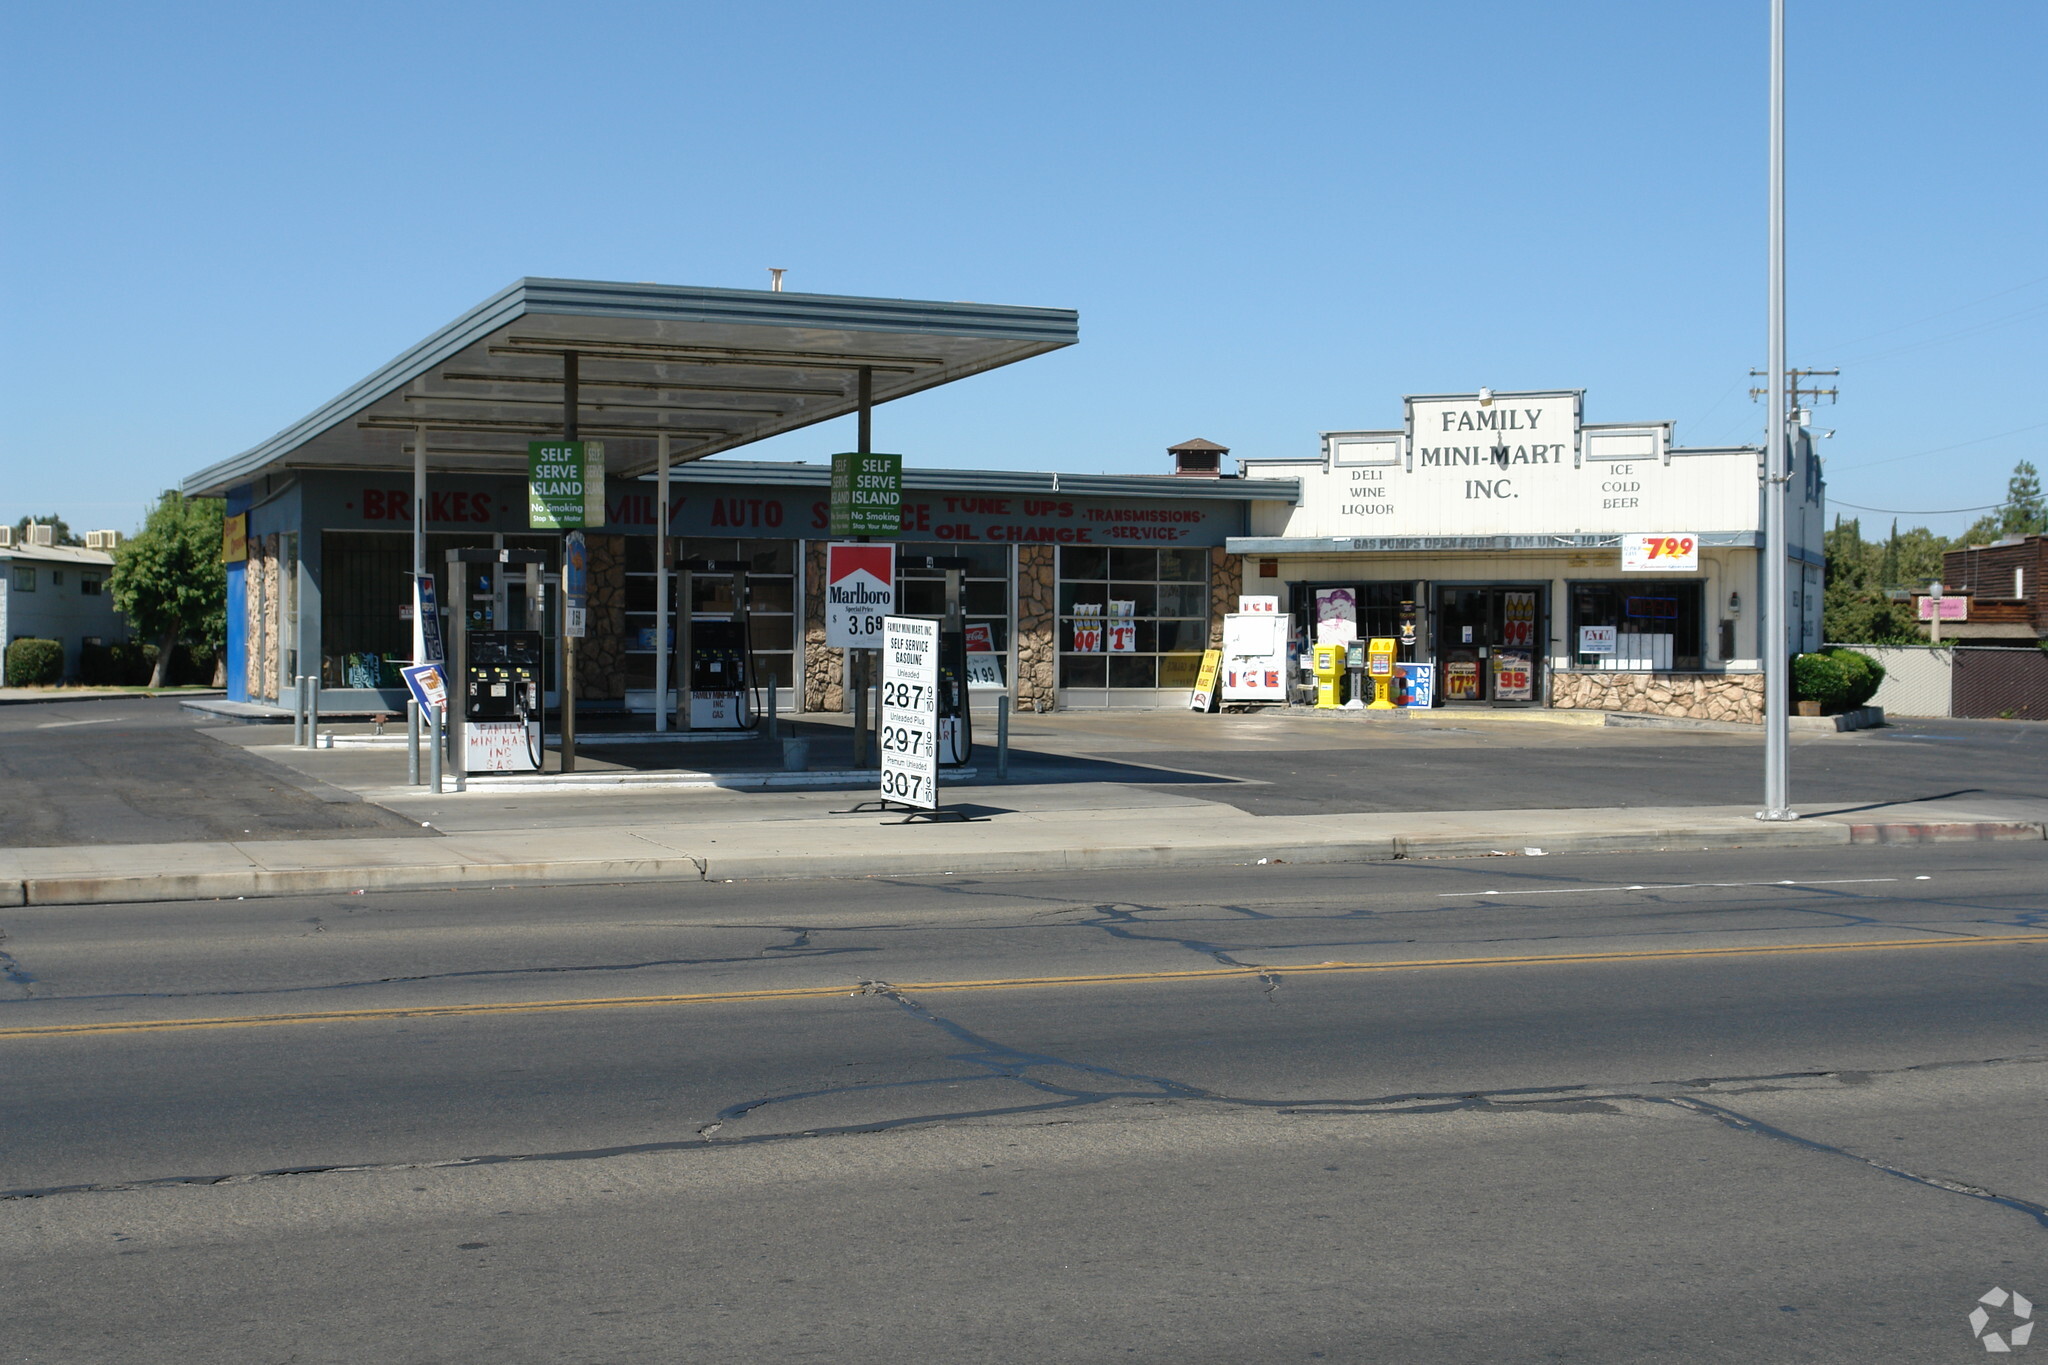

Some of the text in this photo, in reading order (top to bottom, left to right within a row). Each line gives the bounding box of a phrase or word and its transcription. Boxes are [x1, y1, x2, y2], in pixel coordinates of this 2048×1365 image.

[1442, 408, 1543, 431] FAMILY
[541, 448, 572, 462] SELF
[1421, 444, 1565, 467] MINI-MART
[536, 465, 577, 478] SERVE
[862, 459, 892, 472] SELF
[1610, 464, 1634, 475] ICE
[1351, 470, 1383, 480] DELI
[532, 482, 583, 495] ISLAND
[857, 475, 896, 489] SERVE
[1602, 482, 1640, 493] COLD
[1350, 487, 1386, 498] WINE
[1465, 479, 1519, 500] INC.
[852, 491, 900, 505] ISLAND
[1602, 498, 1639, 509] BEER
[531, 503, 544, 512] No
[547, 503, 583, 513] Smoking
[605, 495, 687, 525] MILY
[711, 497, 784, 528] AUTO
[944, 497, 1074, 518] TUNE UPS
[1341, 504, 1394, 516] LIQUOR
[851, 512, 900, 522] No Smoking
[1086, 508, 1202, 523] TRANSMISSIONS
[935, 524, 1092, 543] OIL CHANGE
[1112, 526, 1178, 540] SERVICE
[1354, 538, 1376, 549] GAS
[1380, 537, 1421, 549] PUMPS
[1424, 537, 1458, 548] OPEN
[1460, 536, 1497, 548] FROM
[1516, 536, 1534, 547] AM
[829, 582, 891, 605] Marlboro
[845, 605, 861, 613] Special
[1243, 602, 1273, 611] ICE
[833, 614, 837, 623] $
[887, 622, 901, 633] FAMILY
[901, 623, 911, 634] MINI
[1586, 630, 1611, 641] ATM
[890, 638, 929, 652] SELF SERVICE
[896, 652, 922, 666] GASOLINE
[897, 669, 920, 679] Unleaded
[1229, 666, 1279, 688] ICE
[692, 691, 744, 700] FAMILY MINI-MAT
[884, 682, 934, 712] 287 9 10
[890, 712, 925, 726] Unleaded Plus
[480, 723, 522, 734] FAMILY
[883, 726, 933, 758] 297 9 10
[486, 759, 513, 770] GAS
[887, 756, 927, 771] Premium Unleaded
[882, 769, 932, 803] 307 9 10
